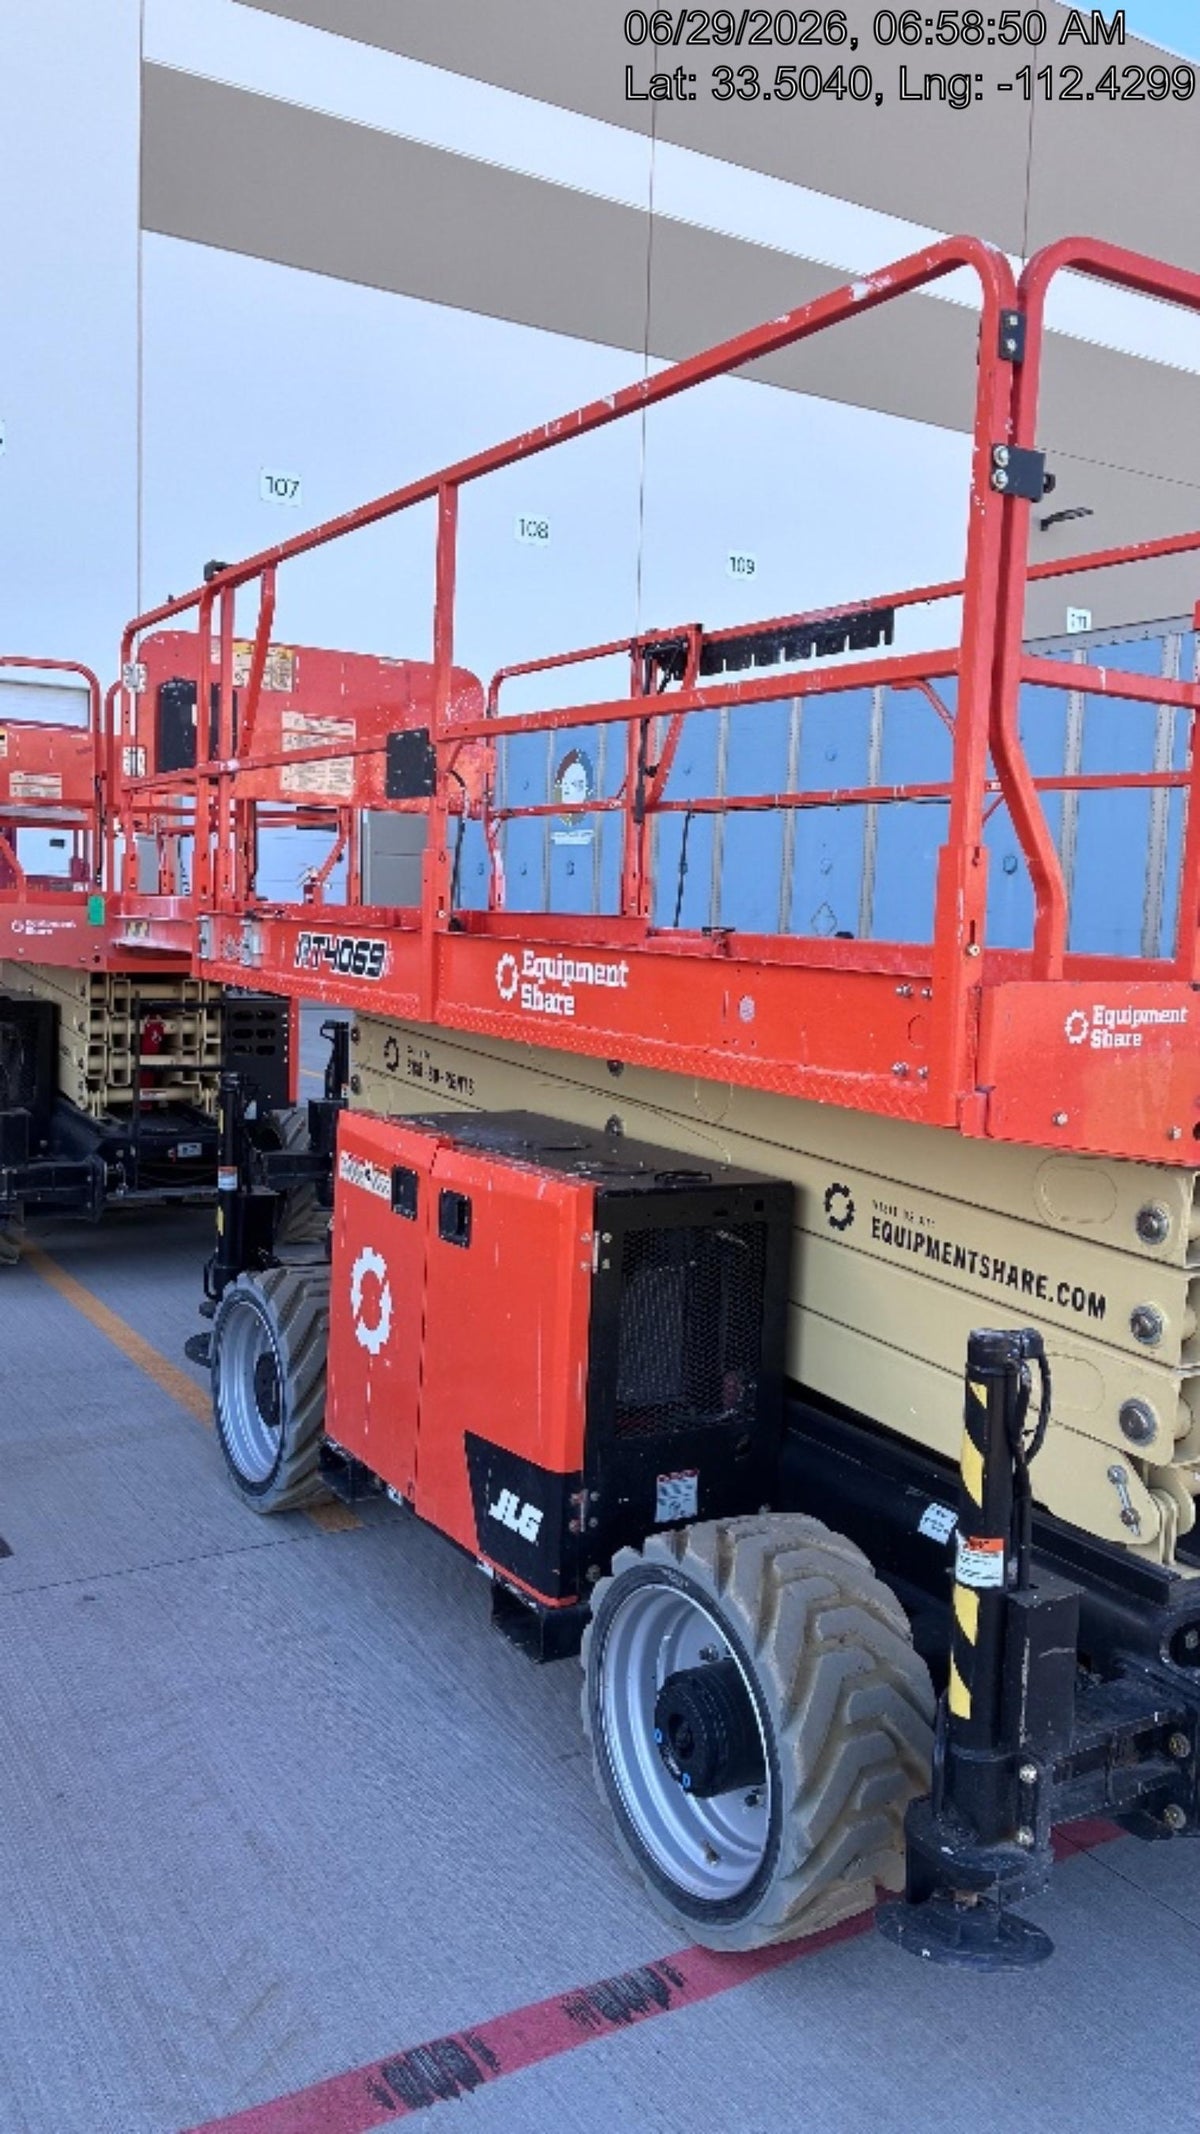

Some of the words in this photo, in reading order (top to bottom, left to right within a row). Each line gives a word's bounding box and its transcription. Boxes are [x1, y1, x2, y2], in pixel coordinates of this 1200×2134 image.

[265, 475, 299, 499] 107
[519, 518, 549, 539] 108
[729, 556, 755, 575] 109
[521, 949, 629, 988] Equipment
[520, 983, 575, 1016] Share
[1092, 1004, 1189, 1030] Equipment
[1090, 1028, 1143, 1049] Share
[871, 1215, 1107, 1320] EQUIPMENTSHARE.COM
[488, 1488, 544, 1544] JLG
